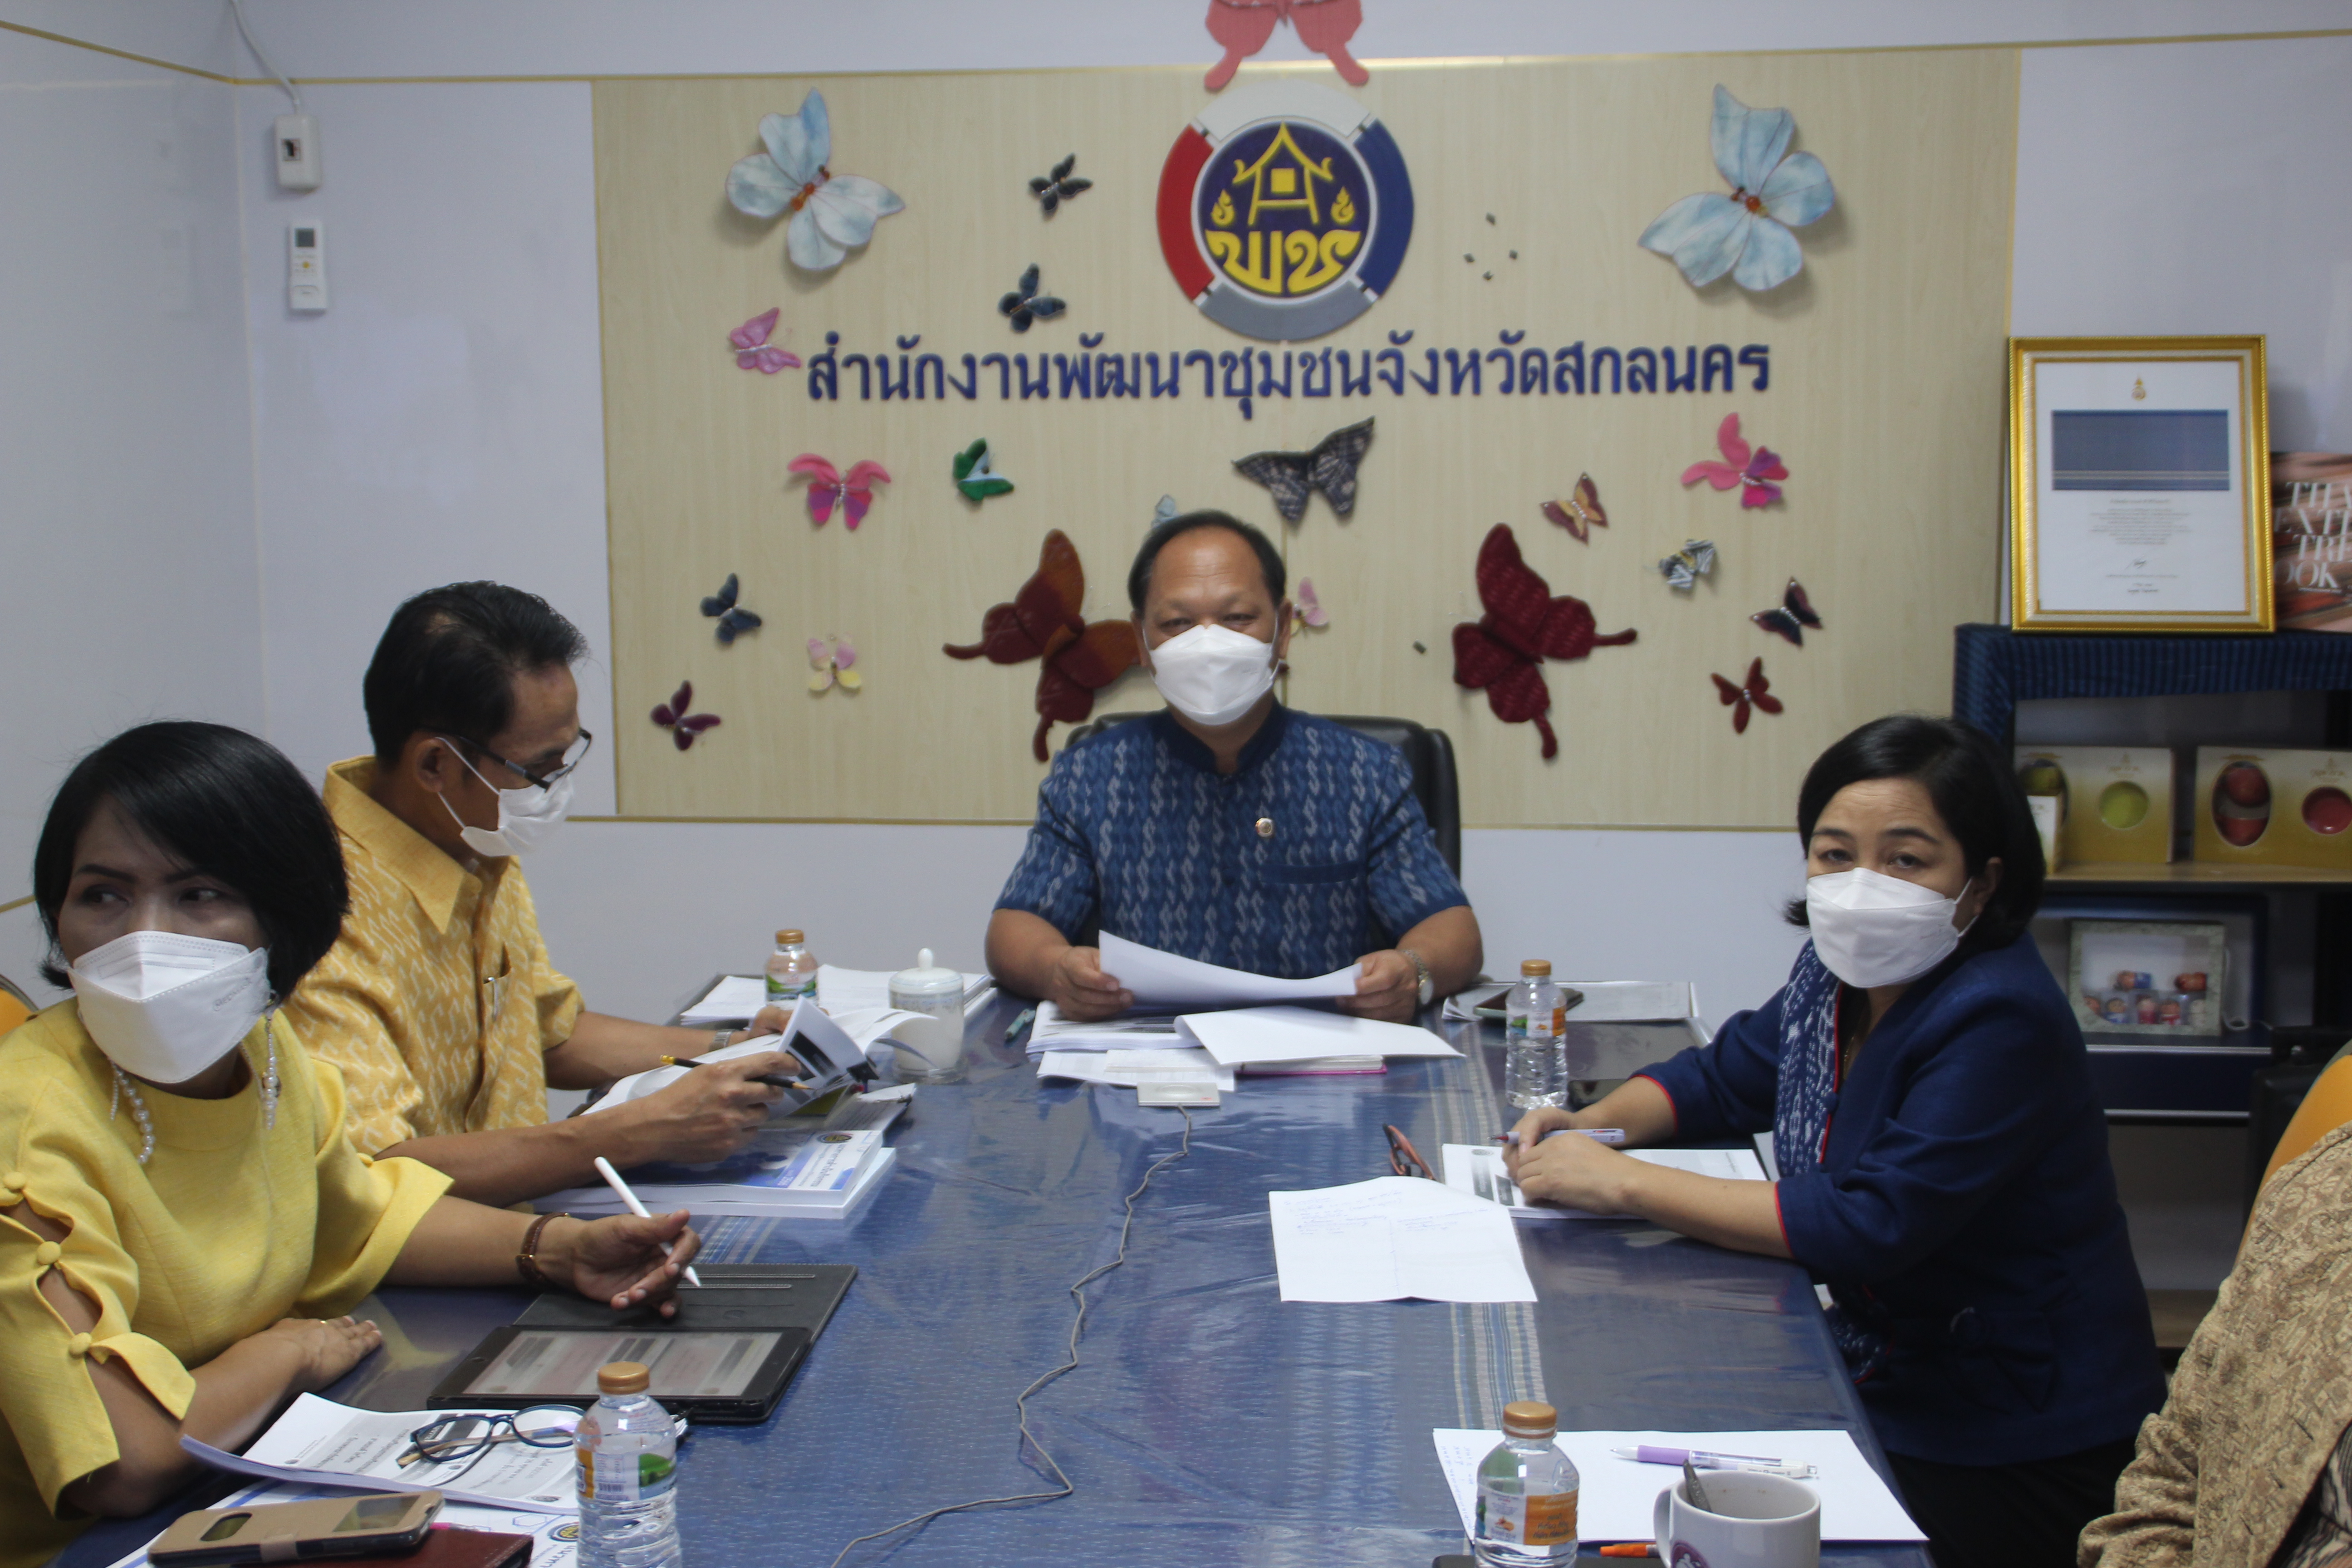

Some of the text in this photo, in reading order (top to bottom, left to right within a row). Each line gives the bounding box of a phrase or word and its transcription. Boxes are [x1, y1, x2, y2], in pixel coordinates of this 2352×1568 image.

[808, 329, 1769, 419] สำนักงานพัฒนาชุมชนจังหวัดสกลนคร
